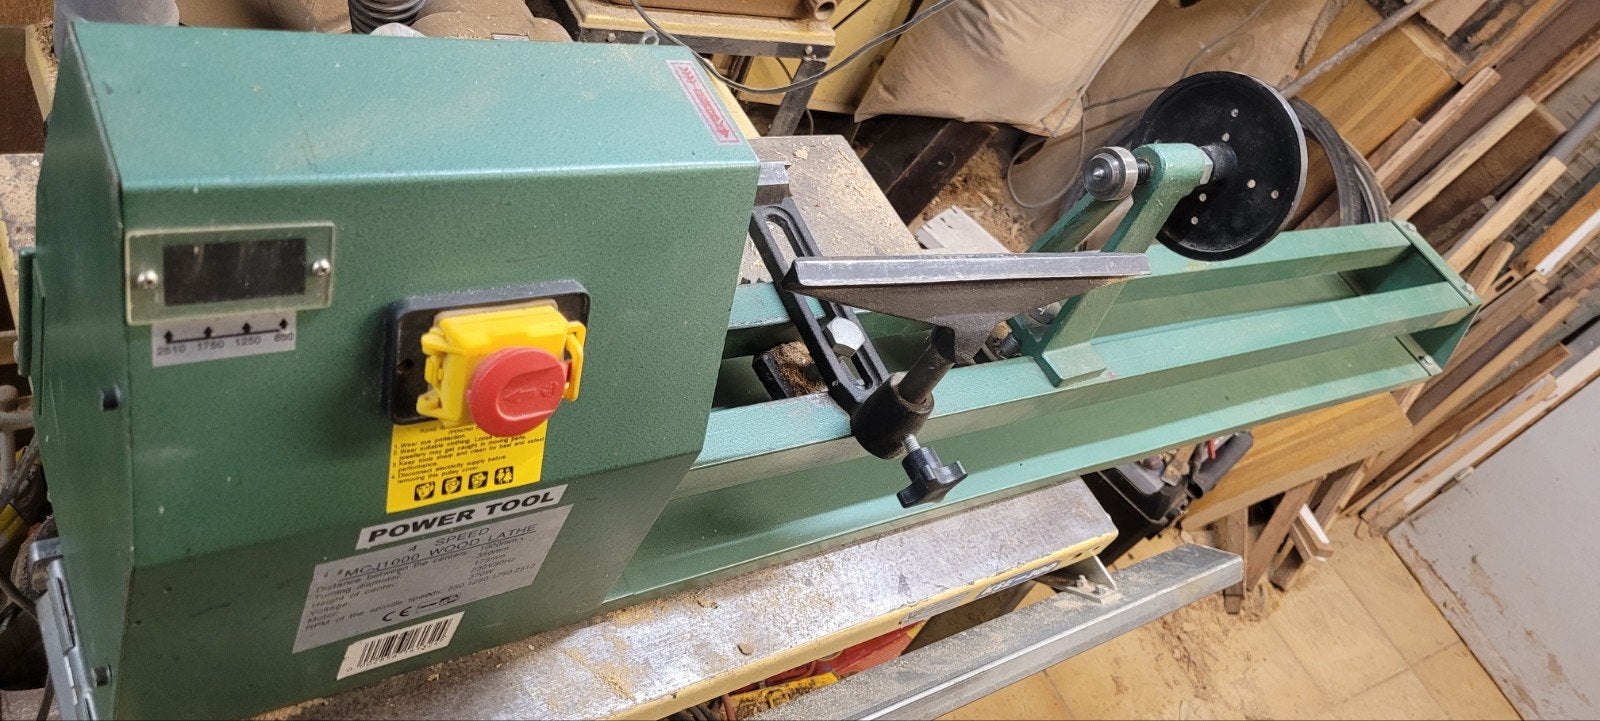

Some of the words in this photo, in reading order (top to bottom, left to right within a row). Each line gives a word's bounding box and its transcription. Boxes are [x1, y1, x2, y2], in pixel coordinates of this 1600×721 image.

[235, 336, 263, 346] 1250
[367, 508, 477, 544] POWER
[485, 490, 555, 516] TOOL
[407, 544, 418, 552] 4
[433, 526, 491, 546] SPEED
[427, 537, 481, 557] WOOD
[486, 523, 538, 542] LATHE
[365, 564, 409, 580] between
[412, 559, 429, 568] the
